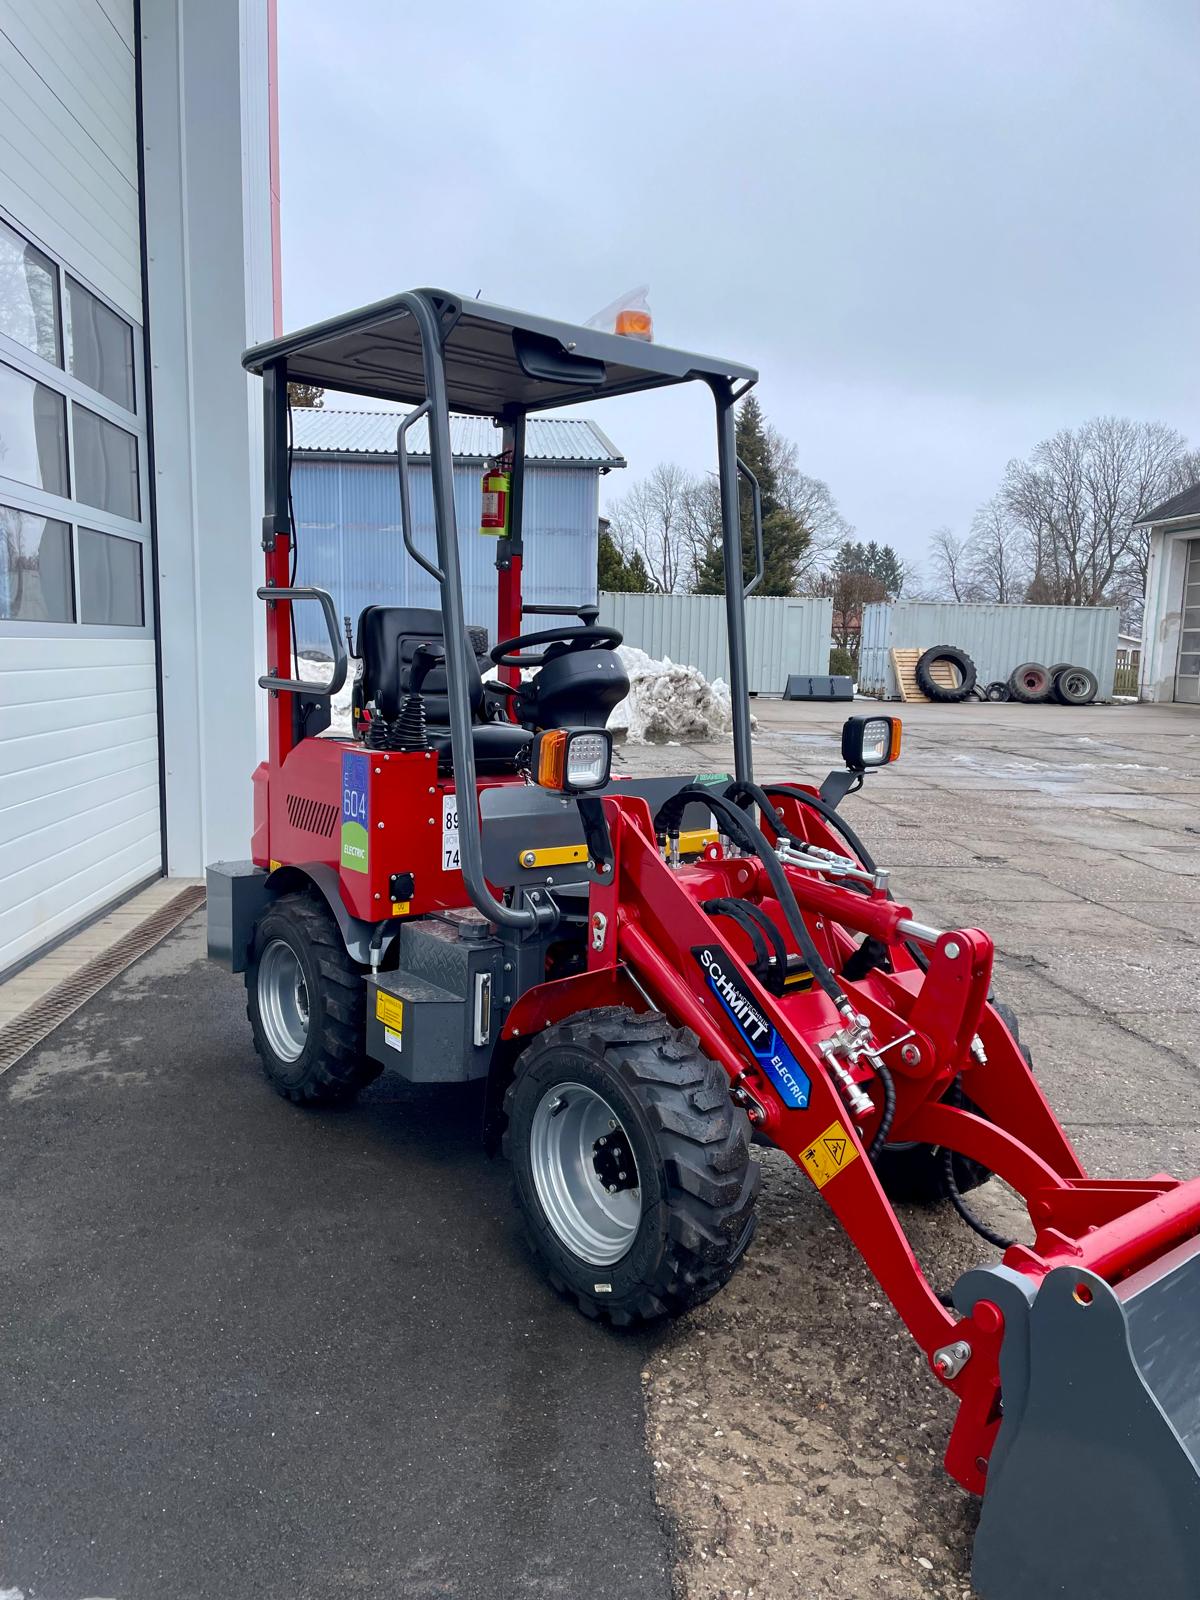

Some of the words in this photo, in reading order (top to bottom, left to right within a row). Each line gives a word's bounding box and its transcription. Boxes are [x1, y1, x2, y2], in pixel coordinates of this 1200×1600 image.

[344, 789, 366, 819] 604
[344, 844, 365, 860] ELECTRIC
[445, 849, 460, 867] 74
[700, 949, 769, 1041] SCHMITT
[732, 985, 770, 1028] LANDTECHNIK
[770, 1055, 807, 1105] ELECTRIC
